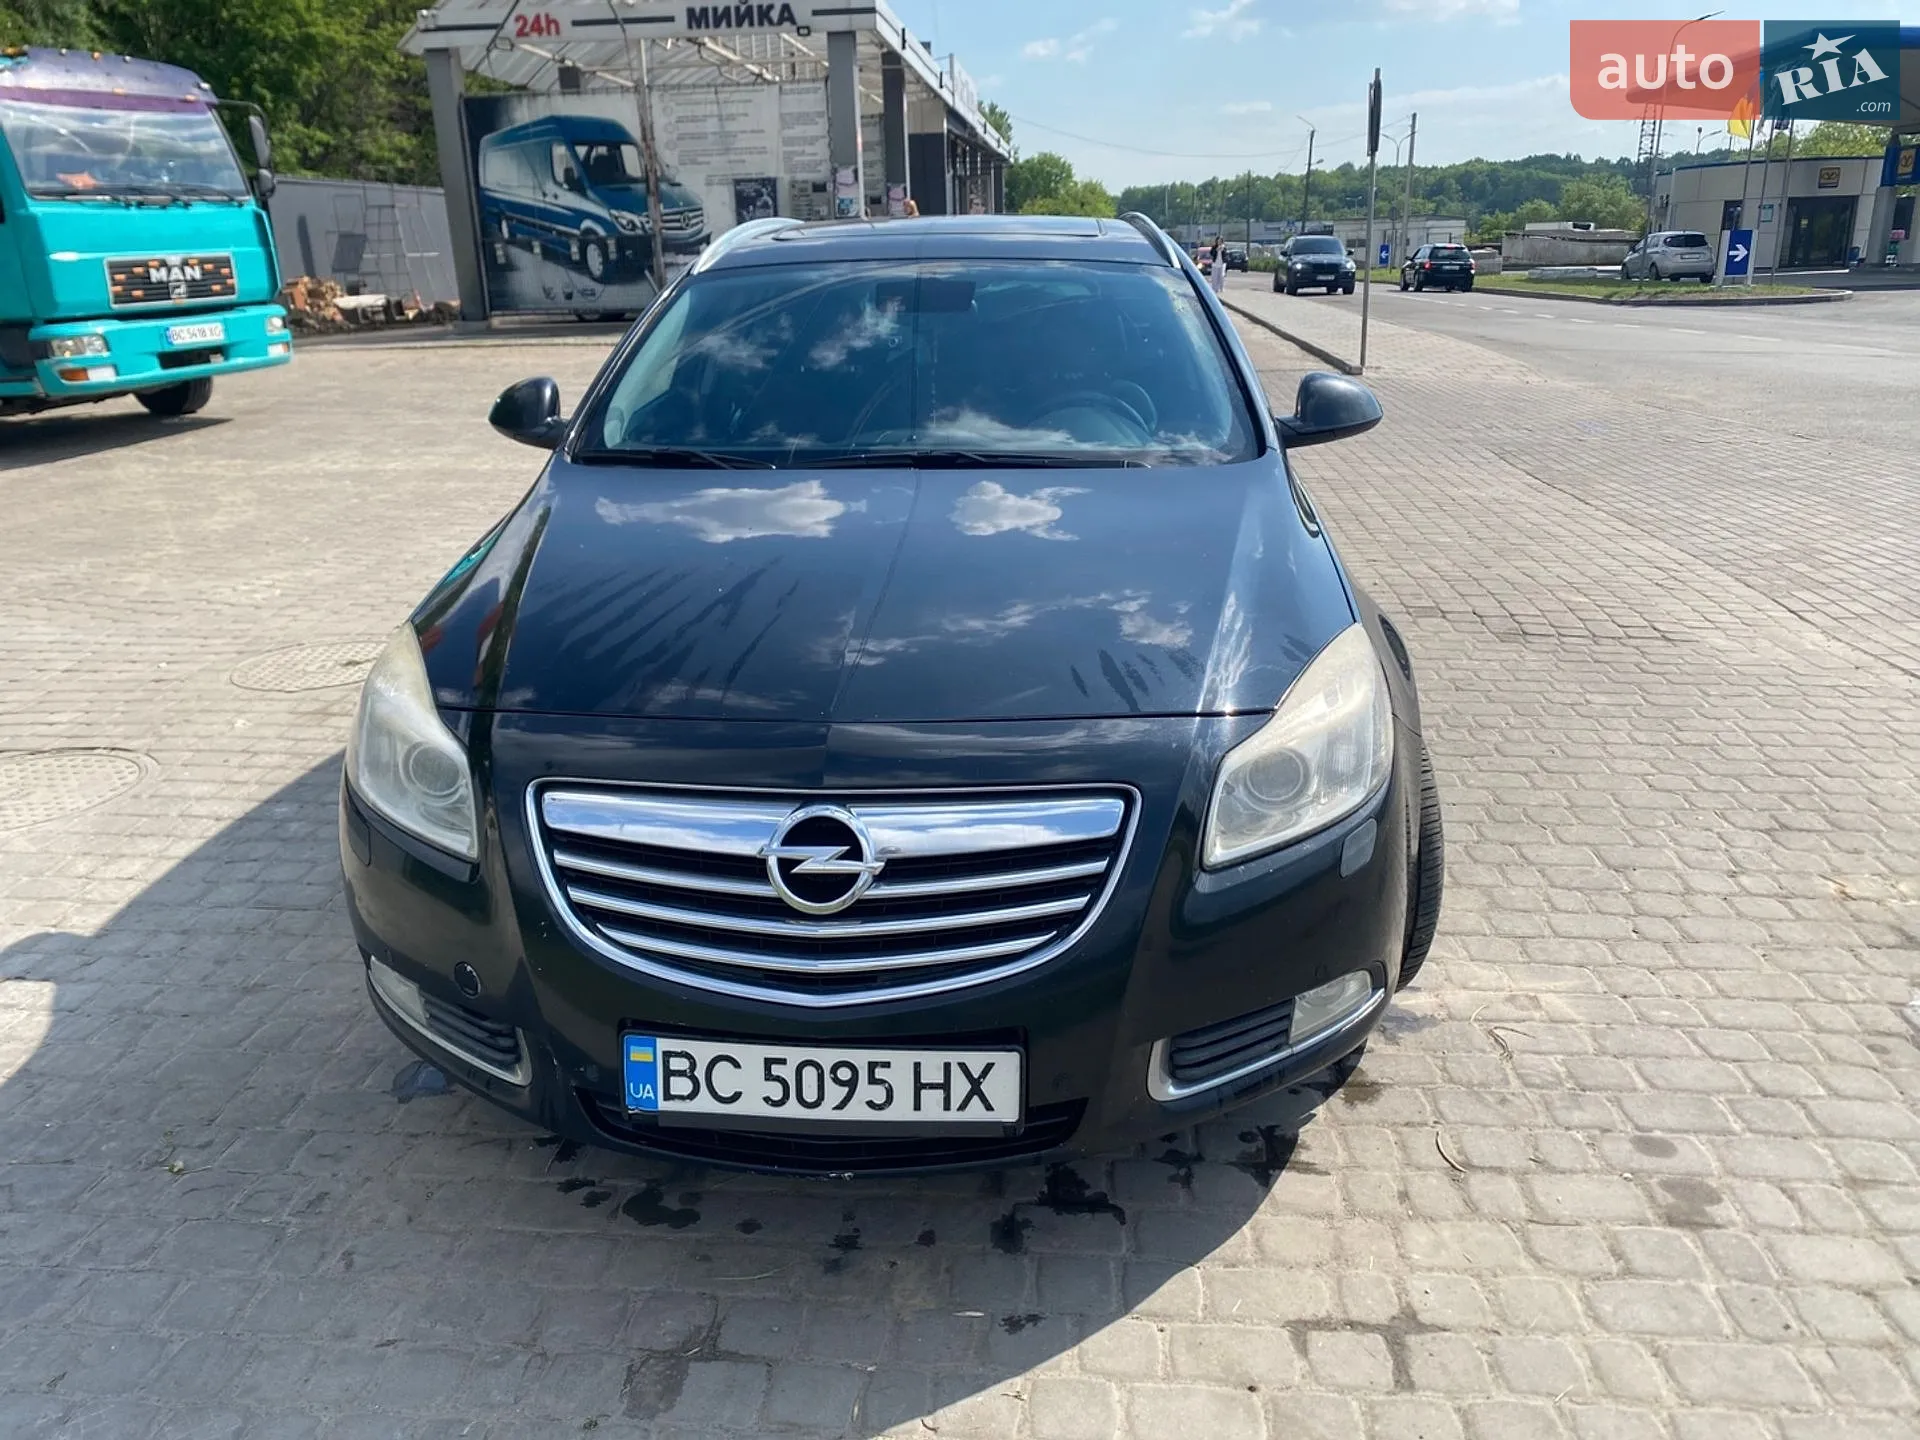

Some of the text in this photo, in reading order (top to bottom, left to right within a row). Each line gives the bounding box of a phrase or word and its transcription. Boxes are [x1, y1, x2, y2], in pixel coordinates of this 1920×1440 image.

[514, 13, 560, 37] 24h
[686, 0, 797, 30] МИЙКА
[149, 264, 201, 283] MAN
[630, 1084, 655, 1101] UA
[662, 1050, 996, 1112] BC 5095 HX
